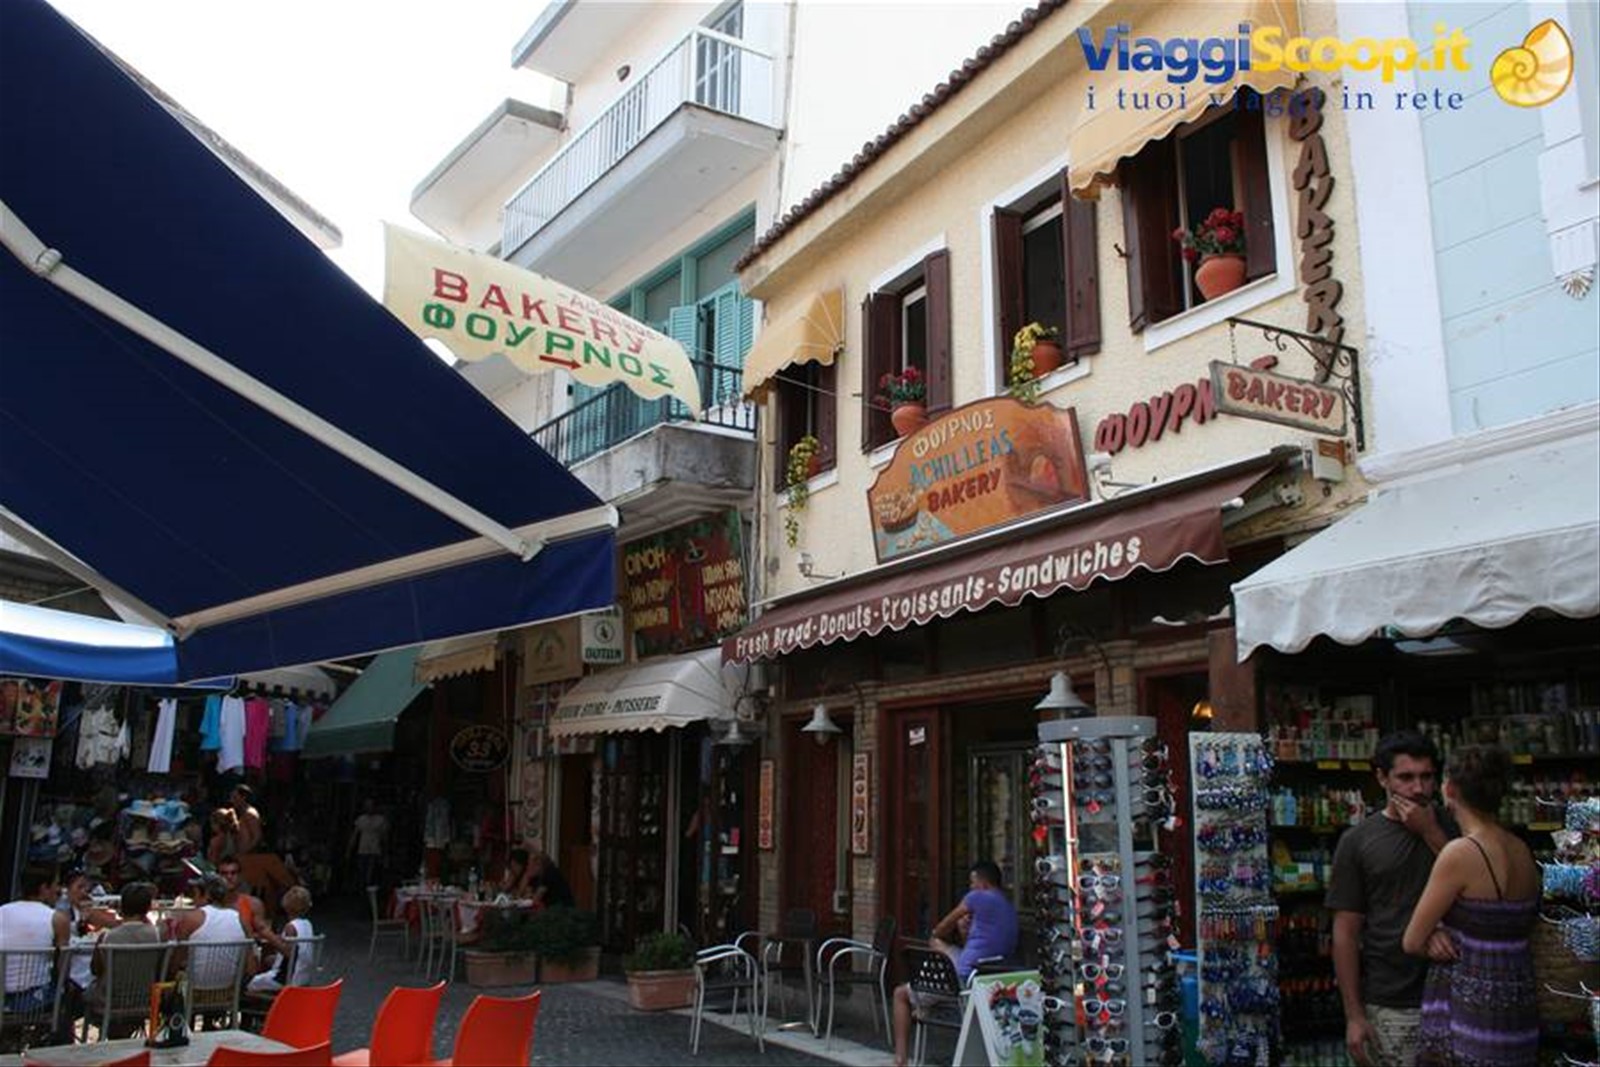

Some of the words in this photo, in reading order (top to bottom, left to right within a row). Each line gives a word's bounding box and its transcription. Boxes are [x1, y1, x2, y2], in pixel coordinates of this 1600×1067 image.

[1288, 86, 1343, 383] BAKERY
[432, 267, 645, 355] BAKERY
[421, 302, 675, 389] ΦΟΥΡΝΟΣ
[1227, 371, 1336, 420] BAKERY
[907, 427, 1015, 490] ACHILLEAS
[911, 408, 995, 459] ΦΟΥΡΝΟΣ
[926, 467, 1002, 514] BAKERY
[735, 631, 770, 658] Fresh
